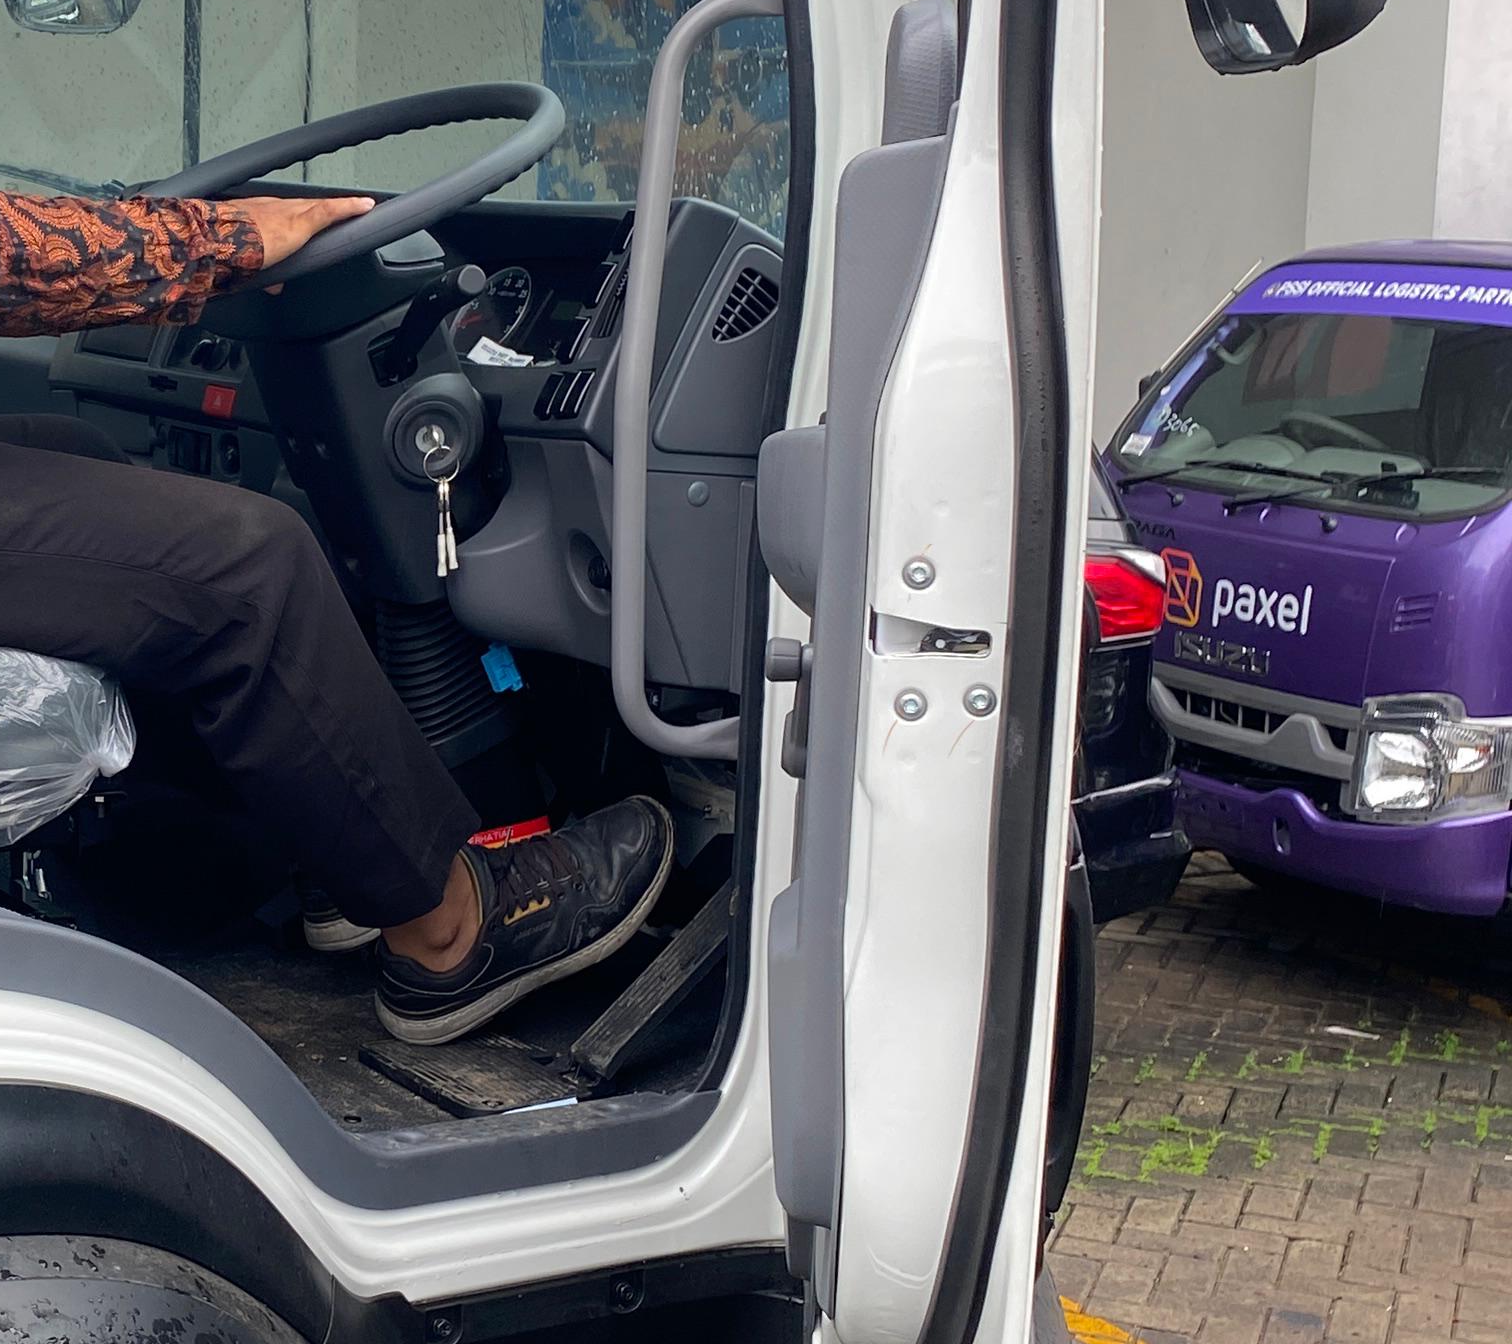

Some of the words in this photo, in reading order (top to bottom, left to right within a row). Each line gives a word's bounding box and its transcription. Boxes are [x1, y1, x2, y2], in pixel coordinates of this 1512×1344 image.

[1308, 280, 1374, 297] OFFICIAL
[1373, 281, 1461, 302] LOGISTICS
[1211, 578, 1314, 636] paxel
[1174, 630, 1272, 676] ISUZU
